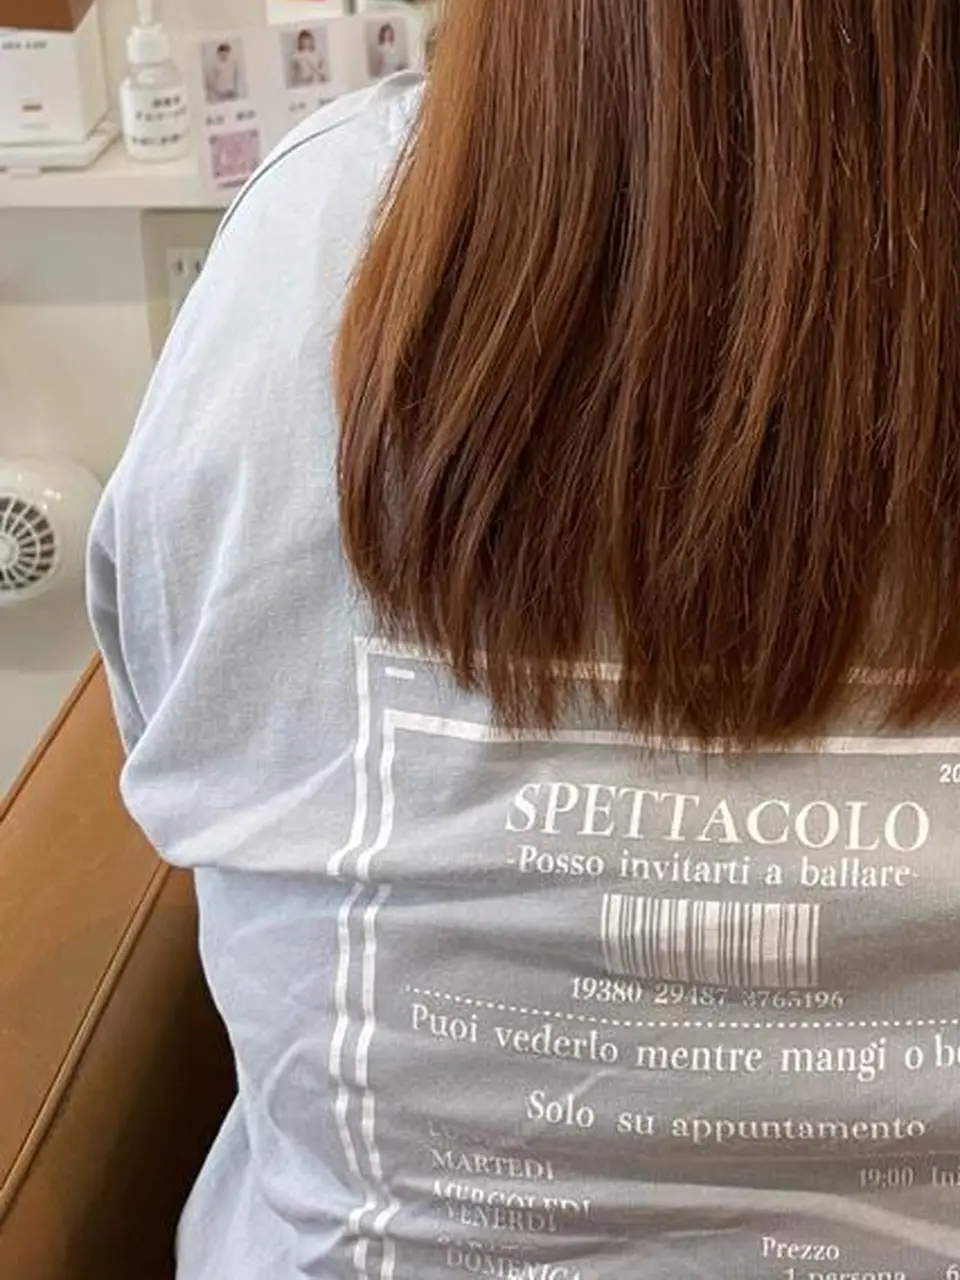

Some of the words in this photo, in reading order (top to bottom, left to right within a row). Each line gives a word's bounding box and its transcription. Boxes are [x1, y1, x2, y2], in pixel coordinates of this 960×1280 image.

[504, 782, 931, 852] SPETTACOLO
[620, 849, 752, 885] invitarti
[764, 863, 784, 886] a
[572, 977, 641, 1003] 19380
[410, 1003, 479, 1044] Puoi
[496, 1021, 620, 1064] vederlo
[636, 1040, 763, 1072] mentre
[781, 1037, 887, 1083] mangi
[904, 1048, 925, 1071] o
[527, 1090, 595, 1128] Solo
[617, 1111, 654, 1136] su
[671, 1116, 926, 1144] appuntamento
[761, 1235, 840, 1261] Prezzo
